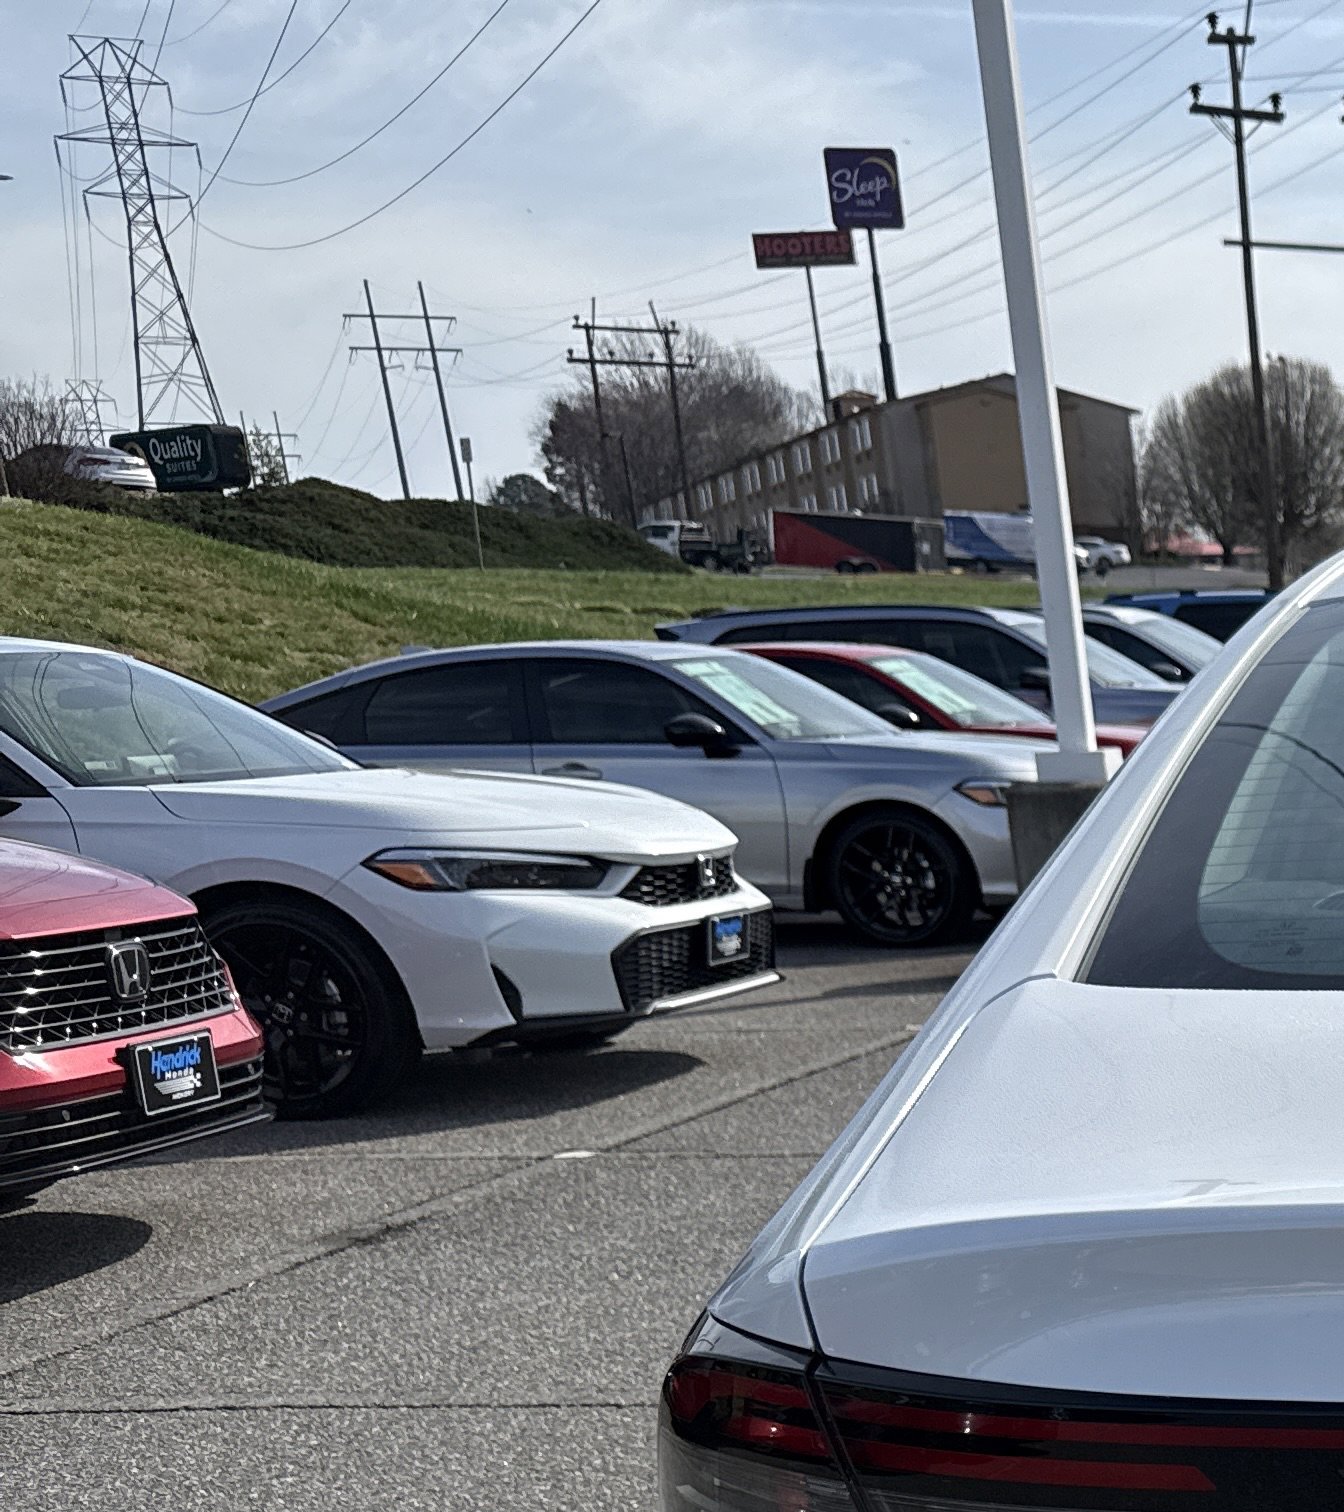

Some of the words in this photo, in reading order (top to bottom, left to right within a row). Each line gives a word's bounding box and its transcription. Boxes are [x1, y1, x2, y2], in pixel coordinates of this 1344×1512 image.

[831, 167, 890, 203] Sleep
[755, 235, 850, 257] HOOTERS
[149, 434, 202, 465] Quality
[166, 460, 197, 473] SUITES
[151, 1042, 201, 1080] Hendrick
[165, 1067, 194, 1080] Honda
